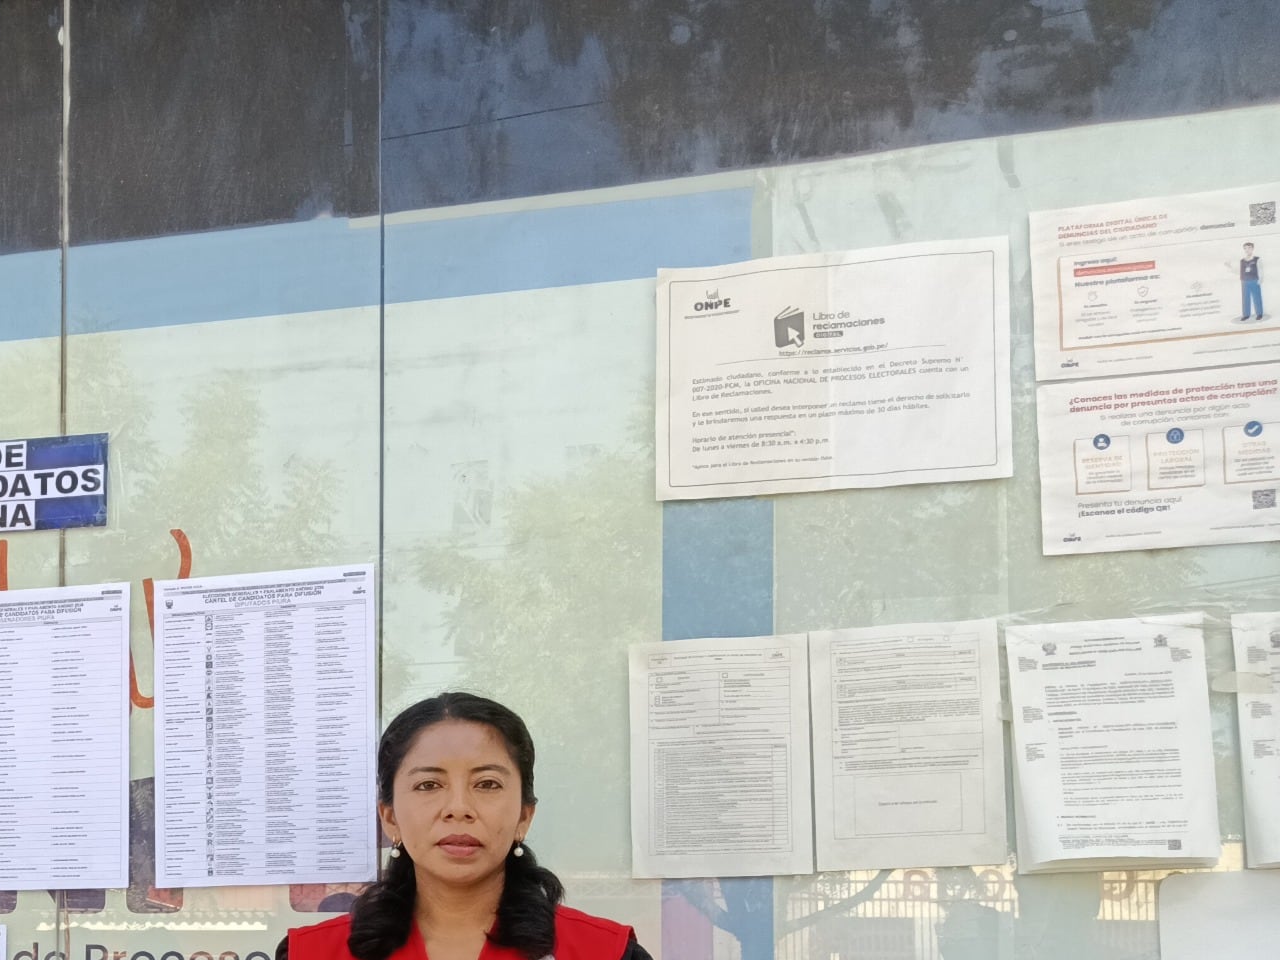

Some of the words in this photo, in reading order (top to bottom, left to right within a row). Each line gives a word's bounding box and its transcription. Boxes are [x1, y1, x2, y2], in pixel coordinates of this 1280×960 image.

[1058, 223, 1104, 231] PLATAFORMA
[1058, 230, 1098, 239] DENUNCIAS
[1113, 223, 1157, 233] CIUDADANO
[694, 298, 731, 311] ONPE
[813, 311, 836, 321] Libro
[837, 310, 850, 319] de
[813, 316, 885, 330] reclamaciones
[869, 368, 916, 379] ELECTORALES
[1069, 394, 1112, 405] ¿Conoces
[1114, 393, 1128, 401] las
[1130, 388, 1170, 399] medidas
[1172, 387, 1183, 395] de
[1186, 383, 1235, 394] protección
[1070, 403, 1112, 413] denuncia
[1114, 401, 1129, 410] por
[1130, 397, 1177, 409] presuntos
[1179, 394, 1205, 403] actos
[1220, 388, 1277, 400] corrupción?
[1078, 500, 1112, 509] Presenta
[1125, 497, 1162, 505] denuncia
[1126, 506, 1154, 514] código
